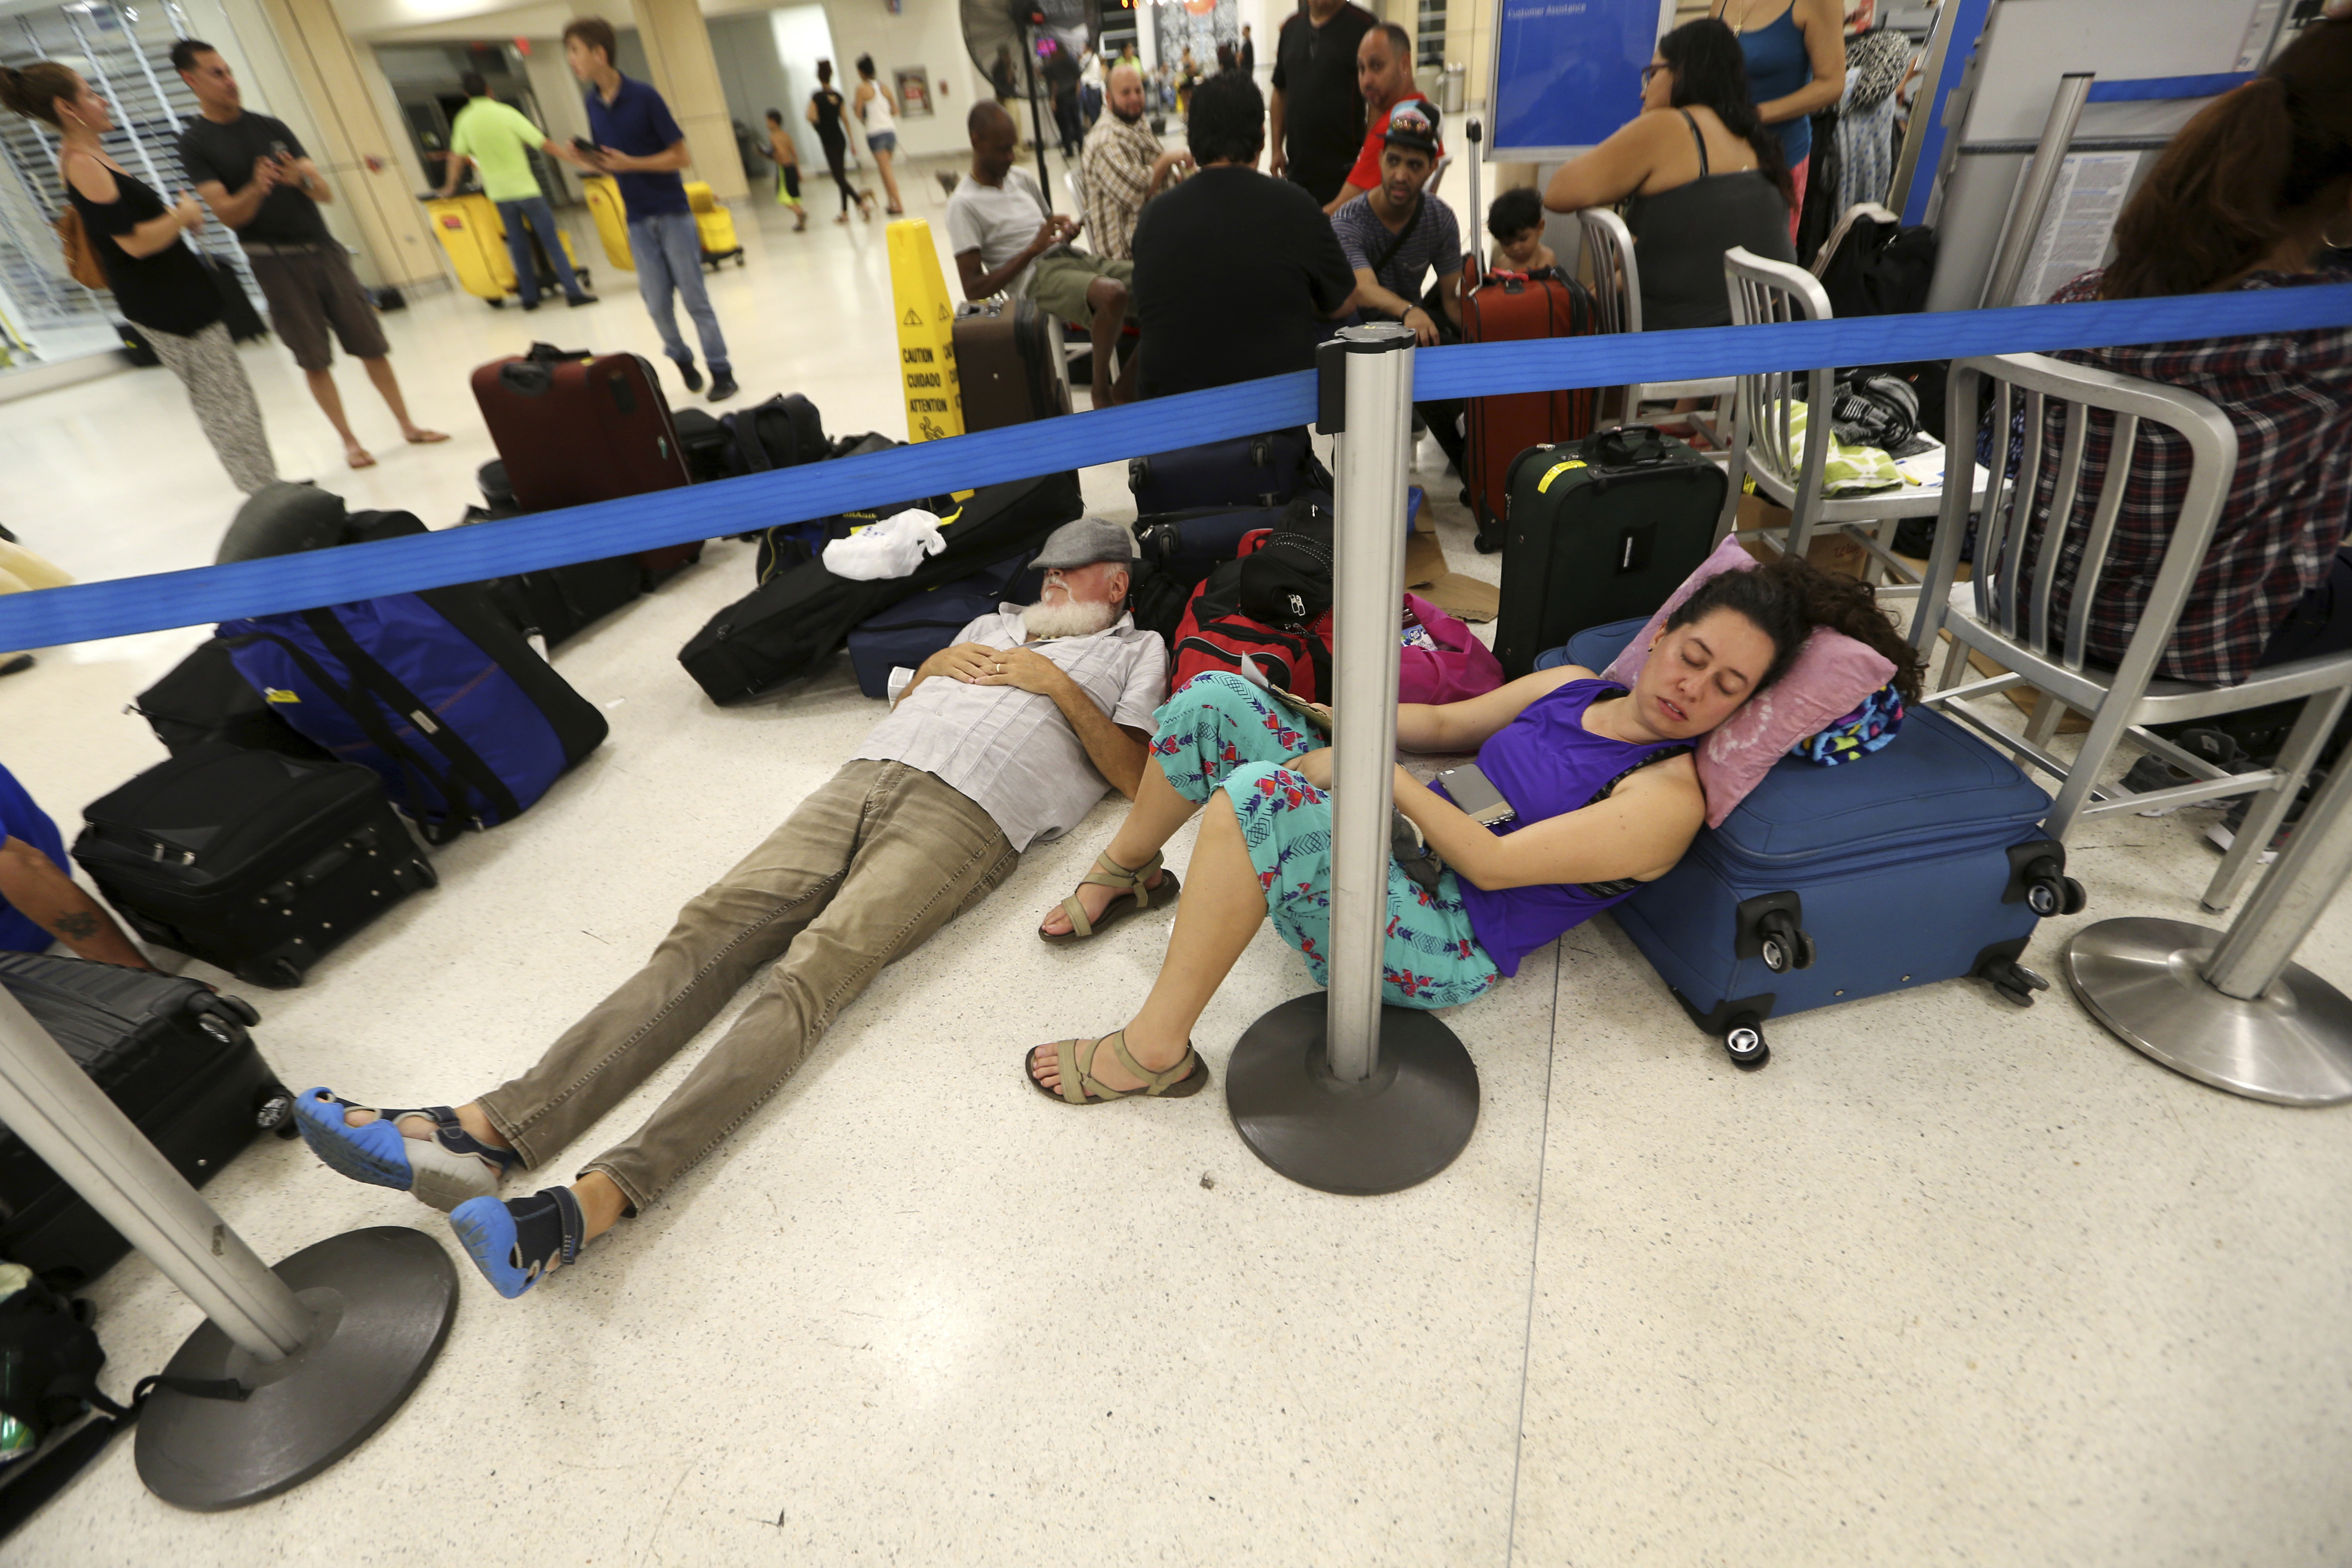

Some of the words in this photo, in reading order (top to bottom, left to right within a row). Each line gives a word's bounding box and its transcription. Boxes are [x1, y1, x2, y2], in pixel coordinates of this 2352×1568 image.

[1545, 3, 1586, 16] Assistance
[902, 347, 934, 363] CAUTION
[906, 372, 941, 387] CUIDADO
[910, 398, 947, 412] ATTENTION
